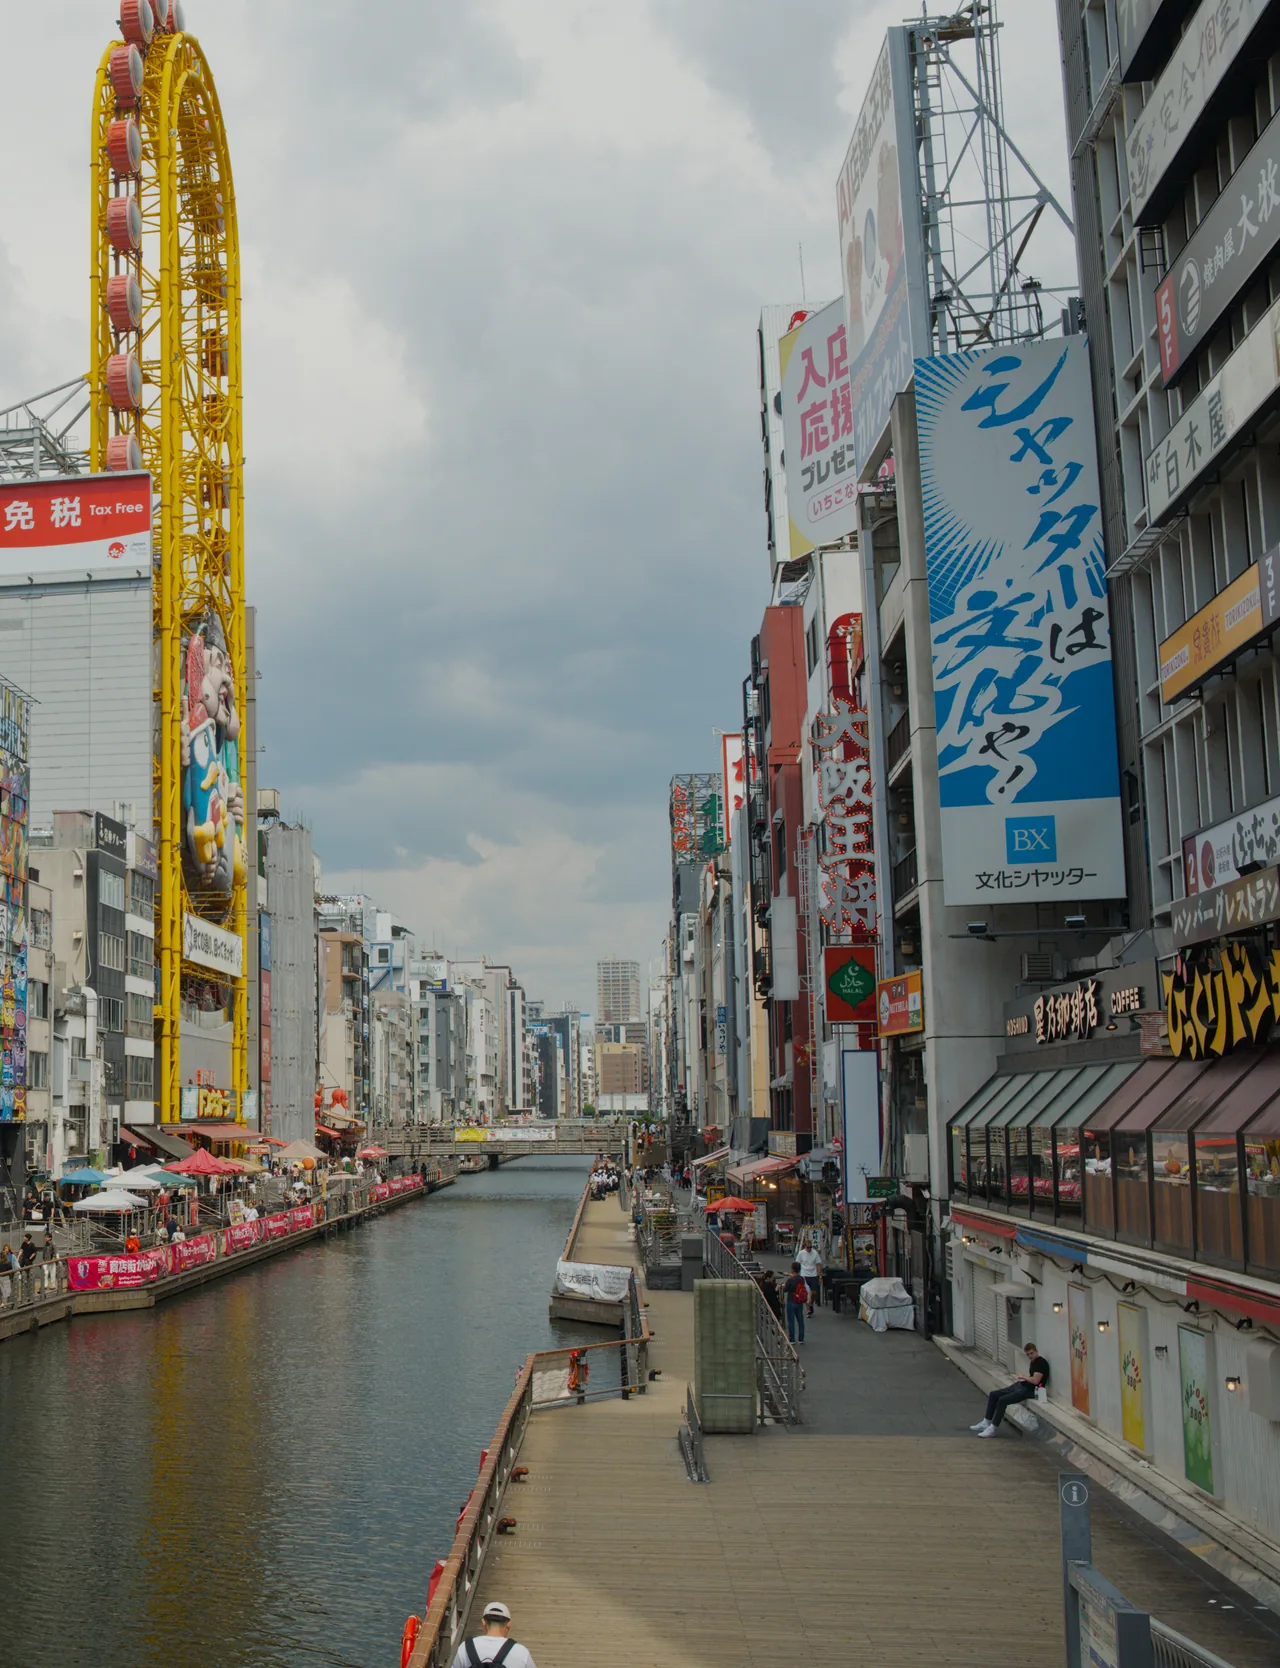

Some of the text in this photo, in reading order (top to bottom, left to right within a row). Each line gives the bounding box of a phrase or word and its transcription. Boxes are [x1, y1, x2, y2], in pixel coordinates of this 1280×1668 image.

[1203, 227, 1236, 291] 焼肉屋
[1161, 289, 1173, 369] 5F
[857, 325, 910, 461] ガルフネット
[1149, 451, 1162, 484] 4F
[1164, 389, 1227, 499] 白木屋
[3, 497, 82, 532] 免税
[89, 502, 144, 516] Tax Free
[1192, 612, 1223, 665] 鳥貴族
[812, 698, 878, 934] 大阪王将
[1012, 828, 1051, 851] BX
[1173, 878, 1279, 937] ハンバーグレストラン
[1033, 978, 1098, 1045] 星乃珈琲店
[1110, 986, 1140, 1014] COFFEE
